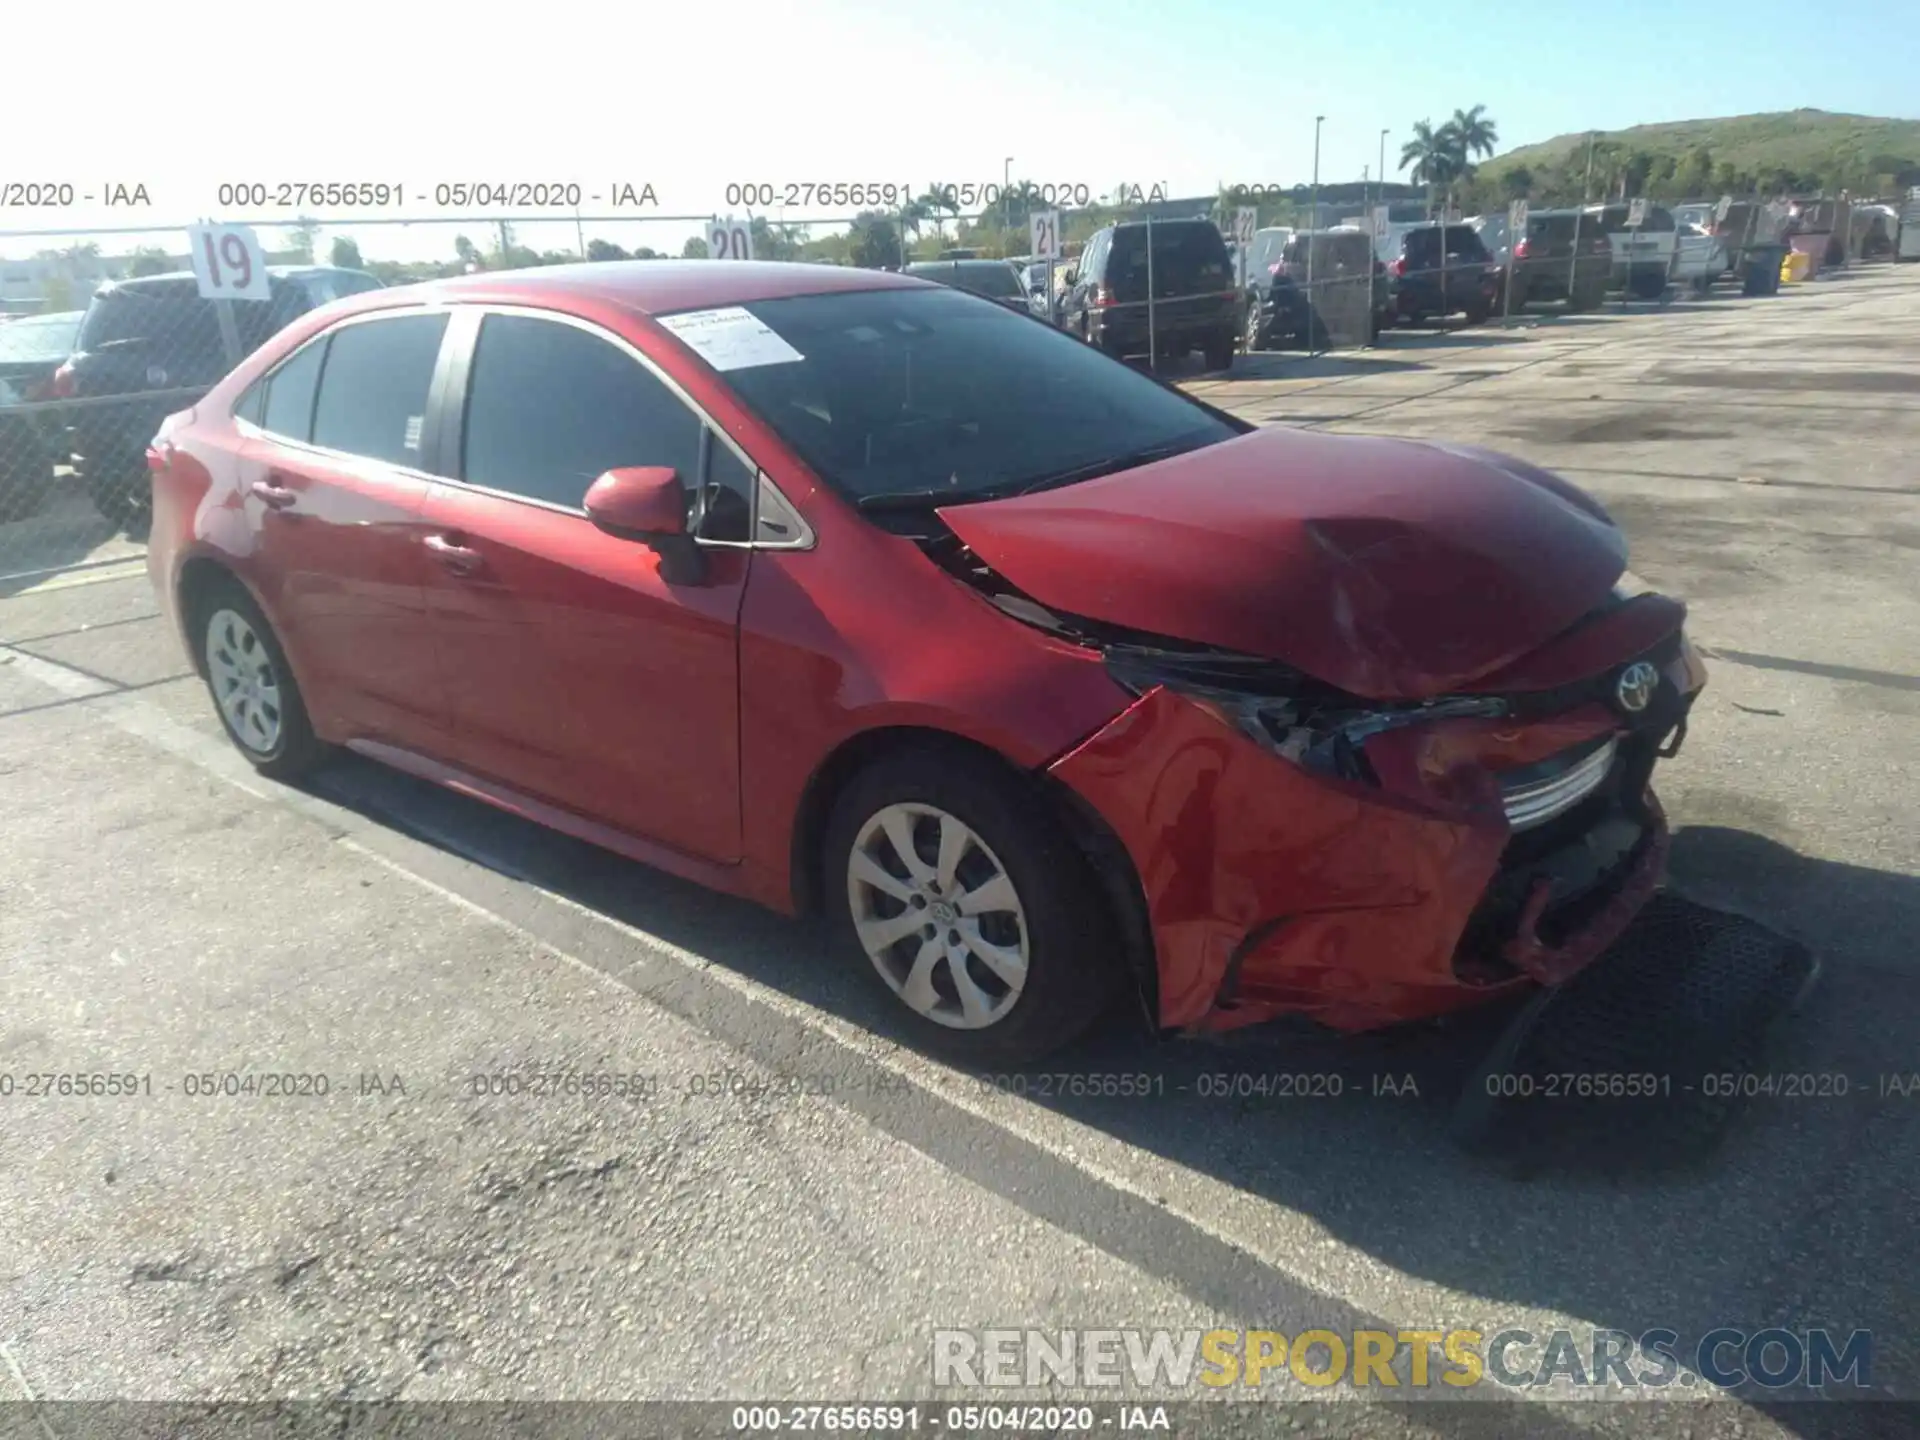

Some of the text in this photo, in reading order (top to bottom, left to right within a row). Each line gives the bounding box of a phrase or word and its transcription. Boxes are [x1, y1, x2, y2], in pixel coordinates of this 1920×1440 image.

[712, 227, 749, 260] 20
[1036, 217, 1055, 254] 21
[202, 231, 251, 290] 19
